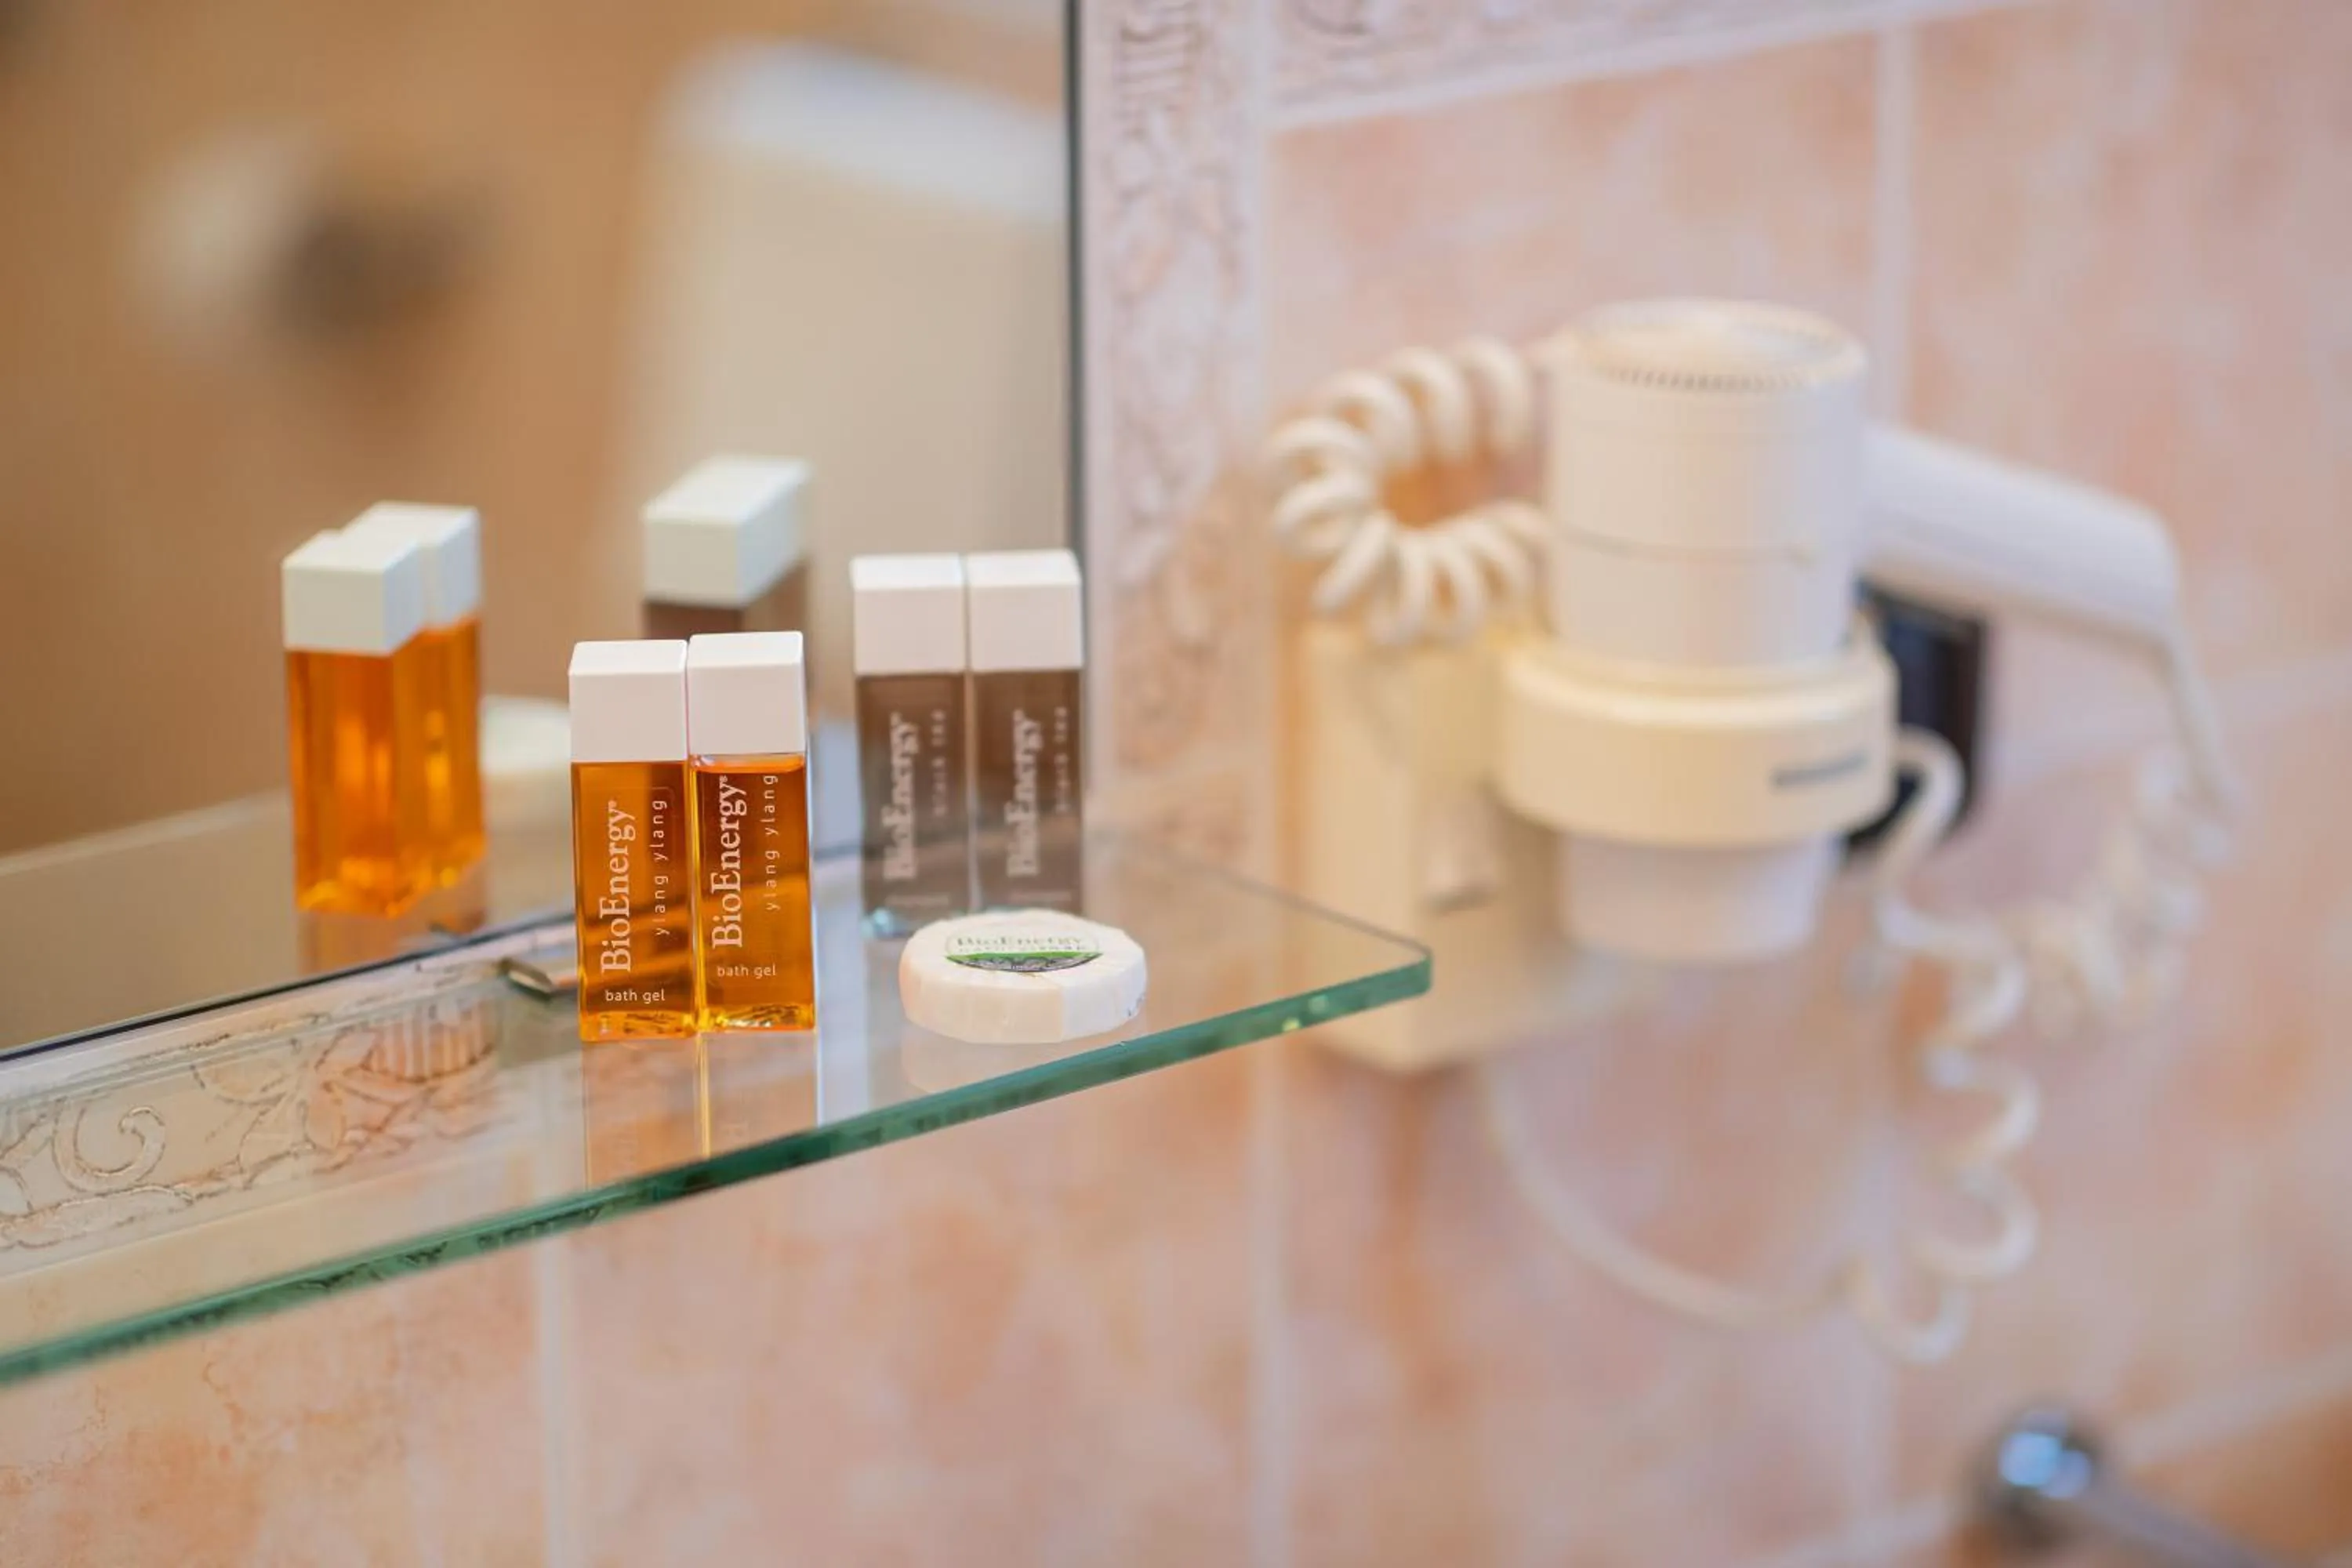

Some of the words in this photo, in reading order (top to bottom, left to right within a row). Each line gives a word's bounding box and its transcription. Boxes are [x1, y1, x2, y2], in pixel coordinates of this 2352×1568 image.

[650, 799, 668, 861] ylang
[760, 775, 779, 836] ylang
[599, 807, 636, 973] BioEnergy
[652, 874, 670, 936] ylang
[762, 850, 780, 911] ylang
[605, 989, 638, 1002] bath
[642, 988, 666, 1004] gel
[717, 965, 750, 978] bath
[755, 964, 777, 980] gel
